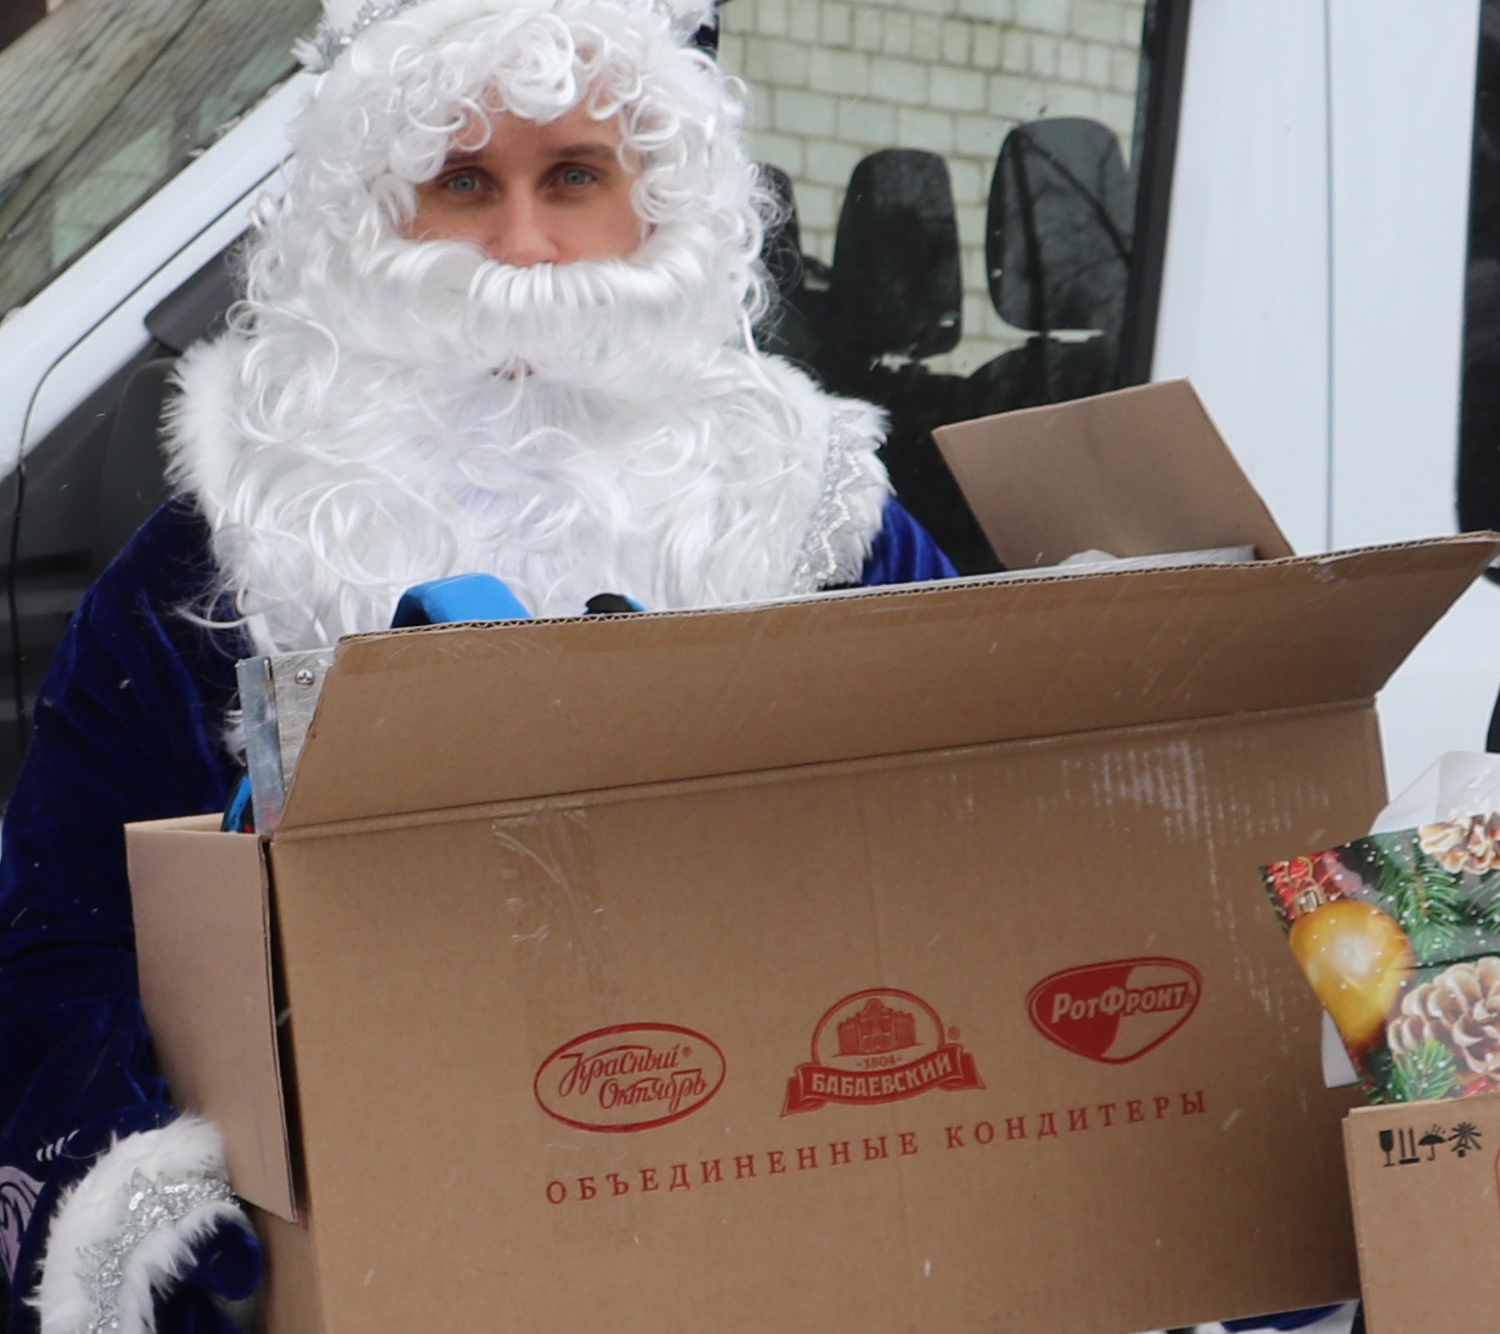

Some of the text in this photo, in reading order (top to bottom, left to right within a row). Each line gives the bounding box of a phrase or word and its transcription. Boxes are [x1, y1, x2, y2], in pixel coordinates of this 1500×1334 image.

[559, 1043, 681, 1096] Красный
[599, 1068, 707, 1113] Октябрь
[812, 1053, 952, 1097] БАБАЕВСКИЙ
[545, 1089, 1207, 1205] ОБЪЕДИНЕННЫЕ КОНДИТЕРЫ
